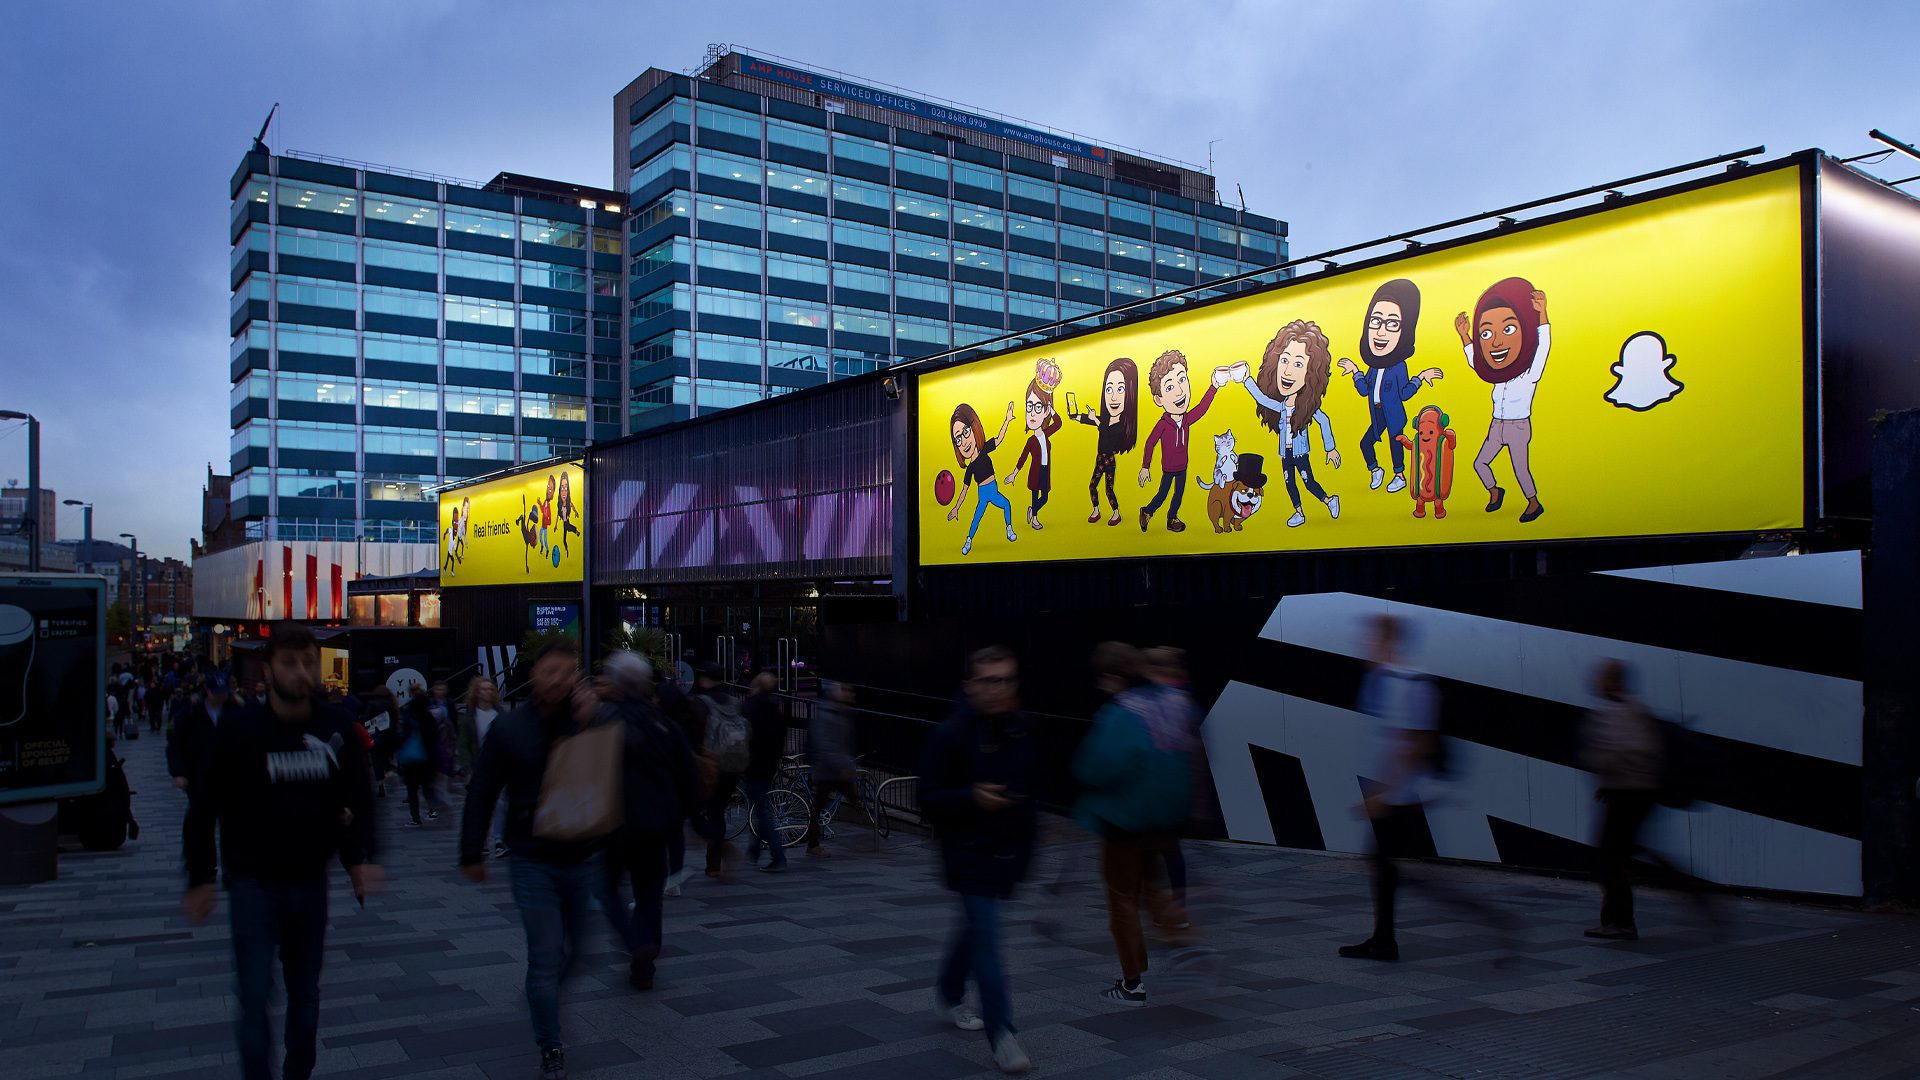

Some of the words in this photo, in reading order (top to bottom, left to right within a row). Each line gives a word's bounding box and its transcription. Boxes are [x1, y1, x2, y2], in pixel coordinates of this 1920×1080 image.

[750, 62, 773, 75] AMP
[776, 69, 813, 86] HOUSE
[820, 79, 870, 100] SERVICED
[874, 93, 917, 112] OFFICES
[931, 107, 946, 119] 020
[1003, 126, 1083, 153] www.amphouse.co.uk
[473, 521, 487, 539] Real
[23, 739, 69, 751] OFFICIAL
[22, 758, 36, 768] OF
